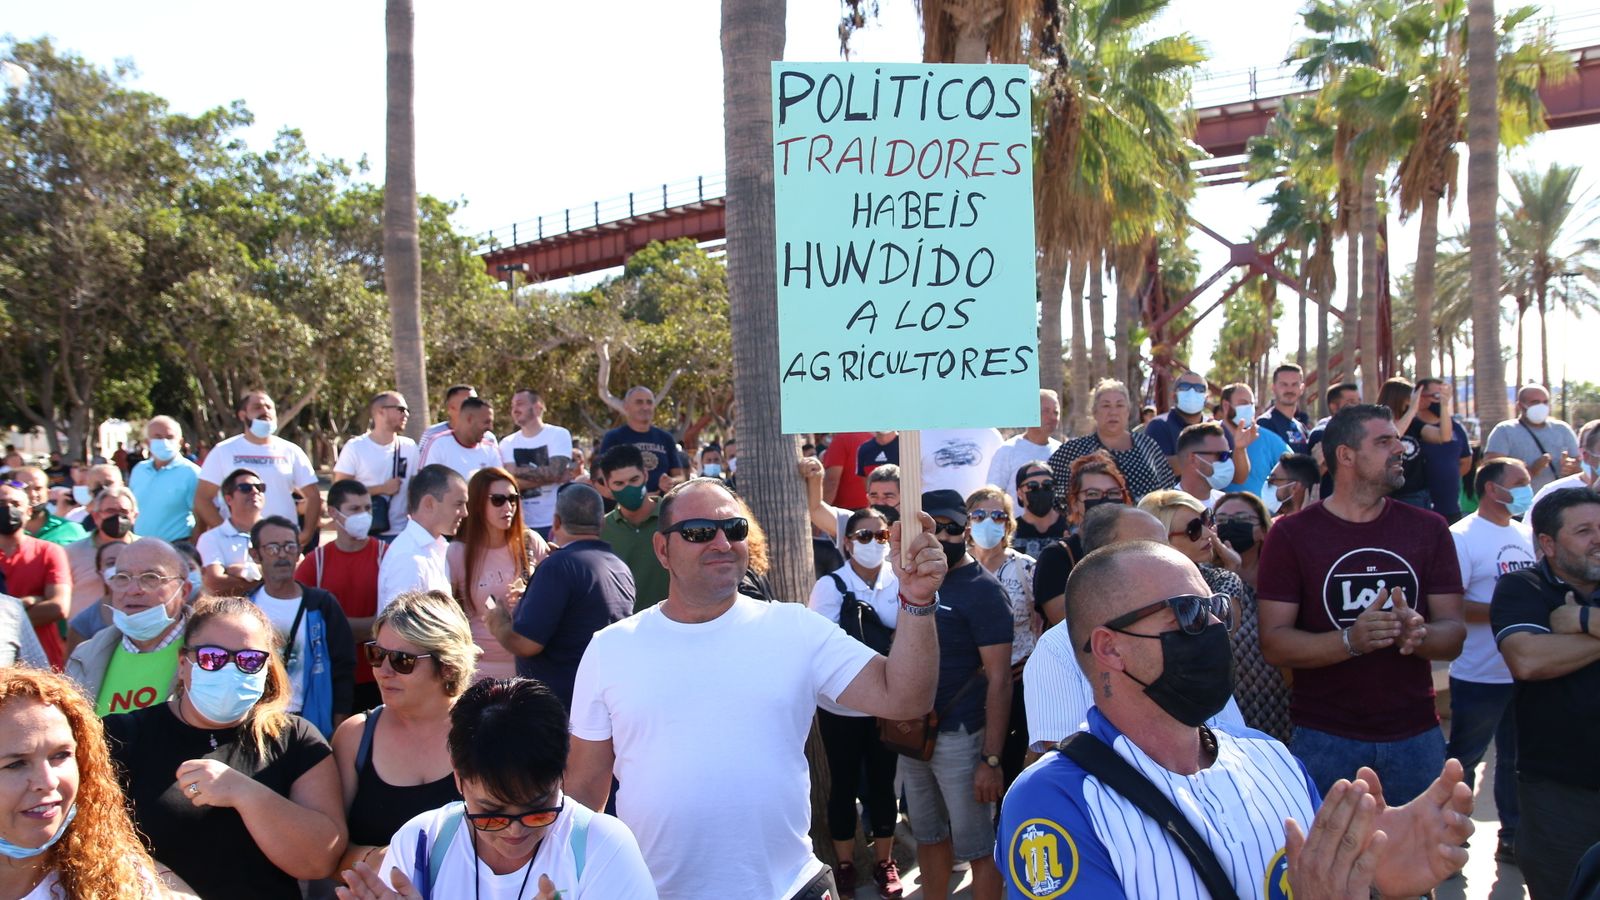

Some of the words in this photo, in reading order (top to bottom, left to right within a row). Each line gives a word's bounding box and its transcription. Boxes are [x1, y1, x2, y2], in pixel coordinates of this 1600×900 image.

[777, 134, 1028, 180] TRAIDORES
[846, 299, 879, 334] A
[894, 298, 977, 332] LOS
[110, 686, 158, 713] NO
